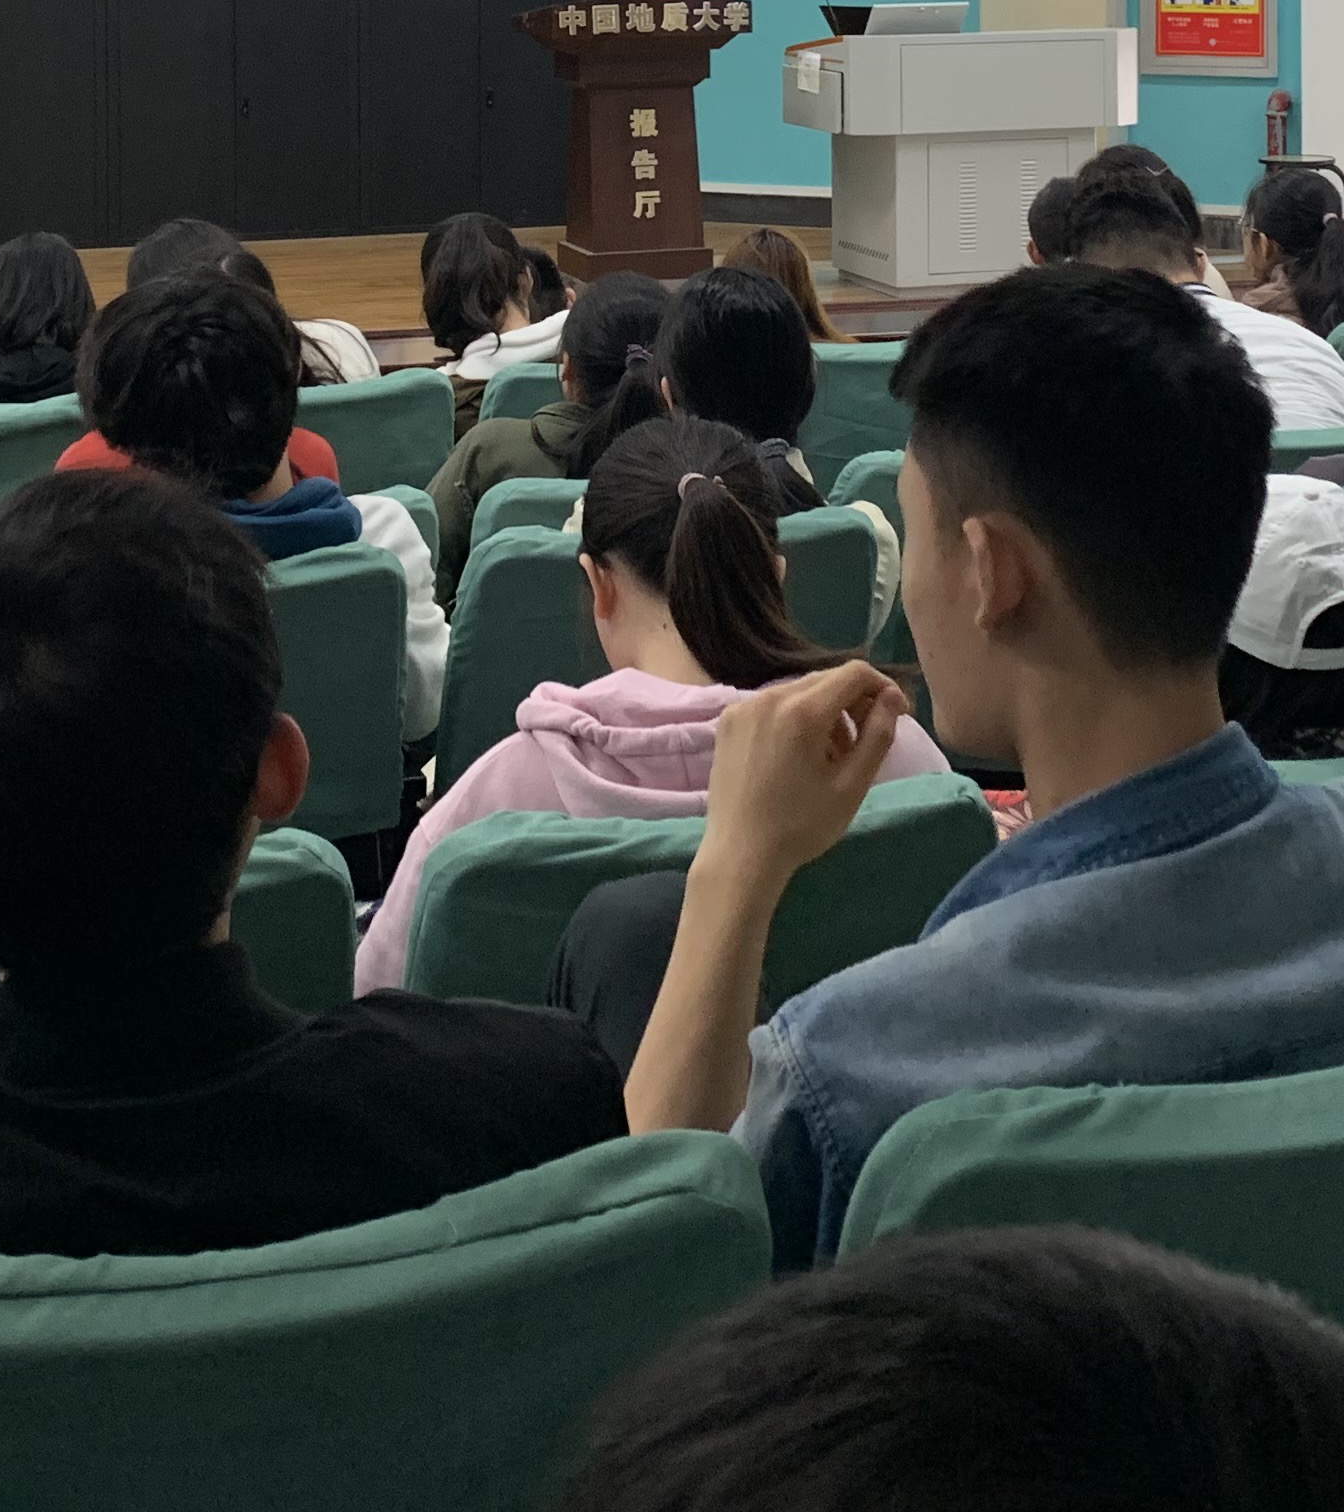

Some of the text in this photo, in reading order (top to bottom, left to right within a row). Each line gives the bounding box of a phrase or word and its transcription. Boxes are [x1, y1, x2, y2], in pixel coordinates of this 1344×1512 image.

[558, 1, 750, 36] 中国地质大学
[629, 108, 662, 219] 报告厅
